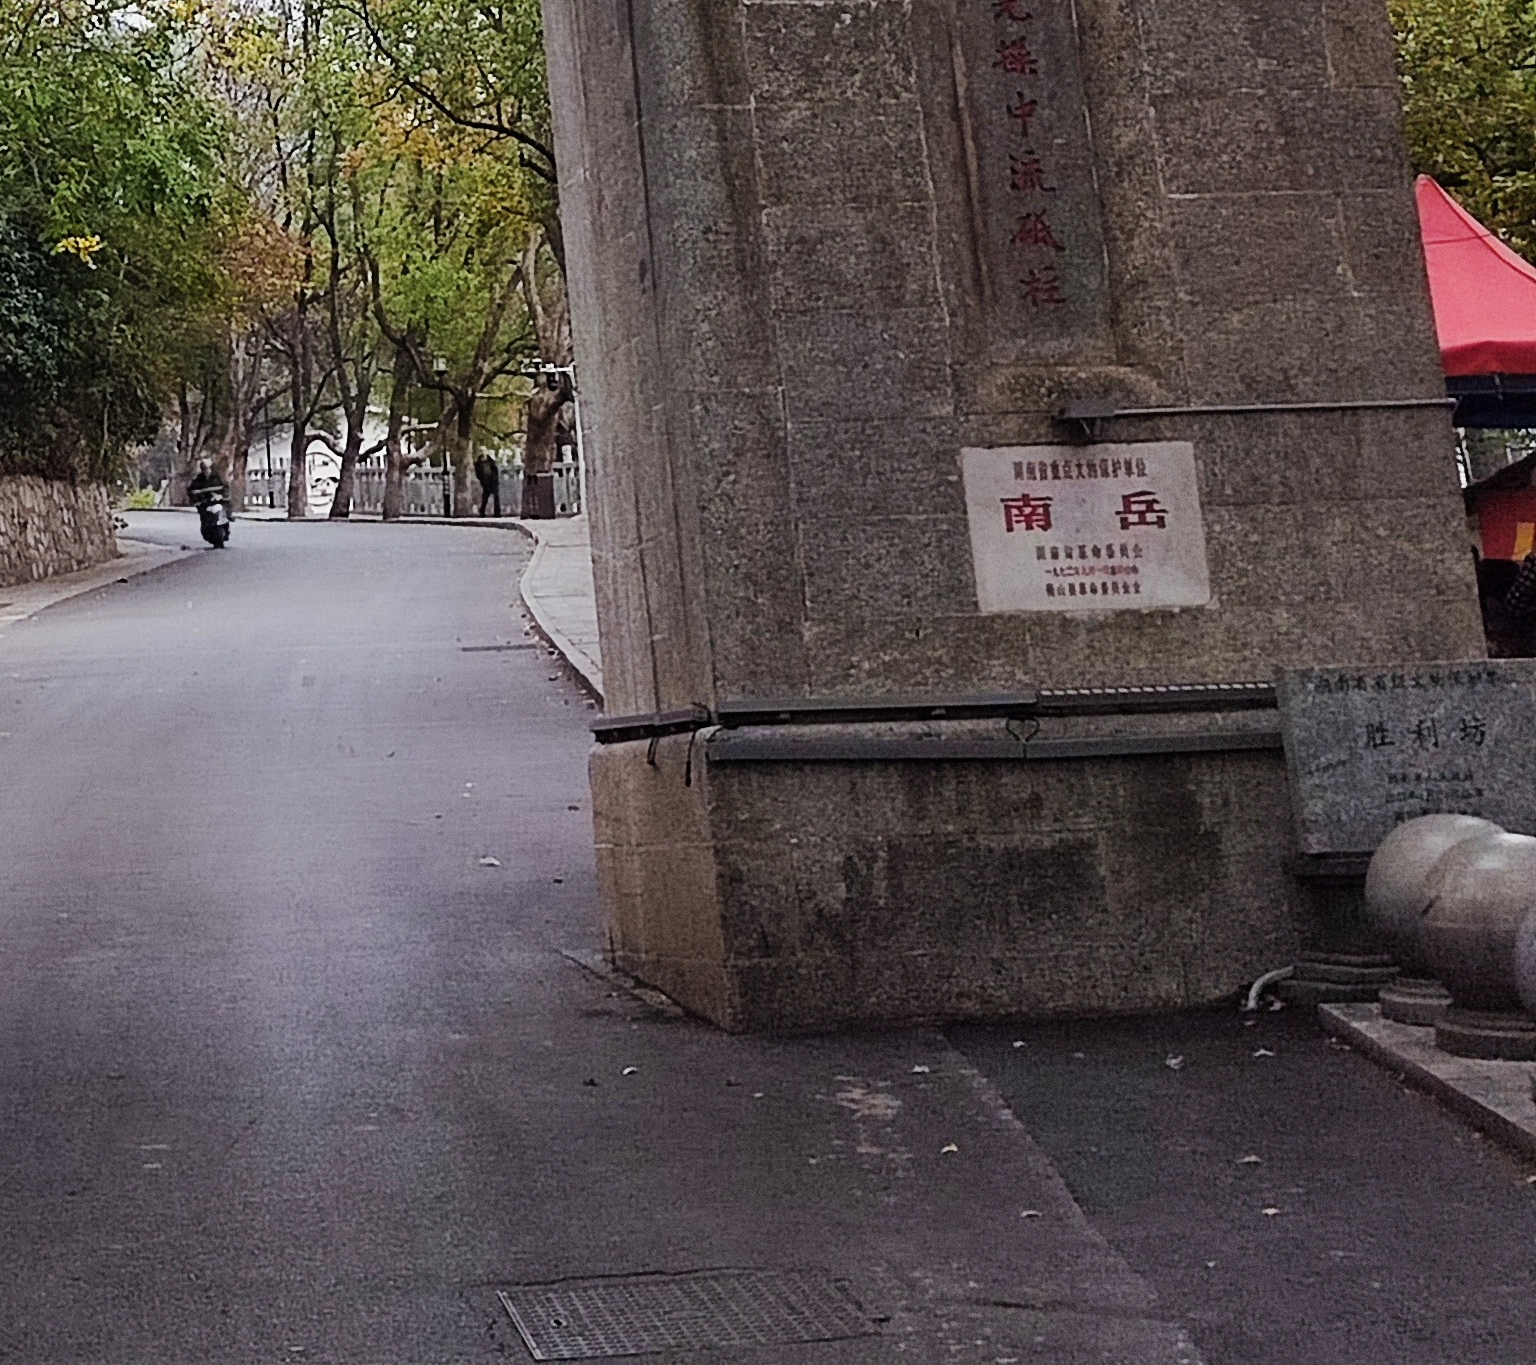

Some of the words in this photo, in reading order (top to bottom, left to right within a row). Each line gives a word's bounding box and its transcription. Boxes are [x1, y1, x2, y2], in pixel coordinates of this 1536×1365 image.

[1000, 491, 1169, 533] 南岳
[1365, 716, 1486, 748] 胜利坊
